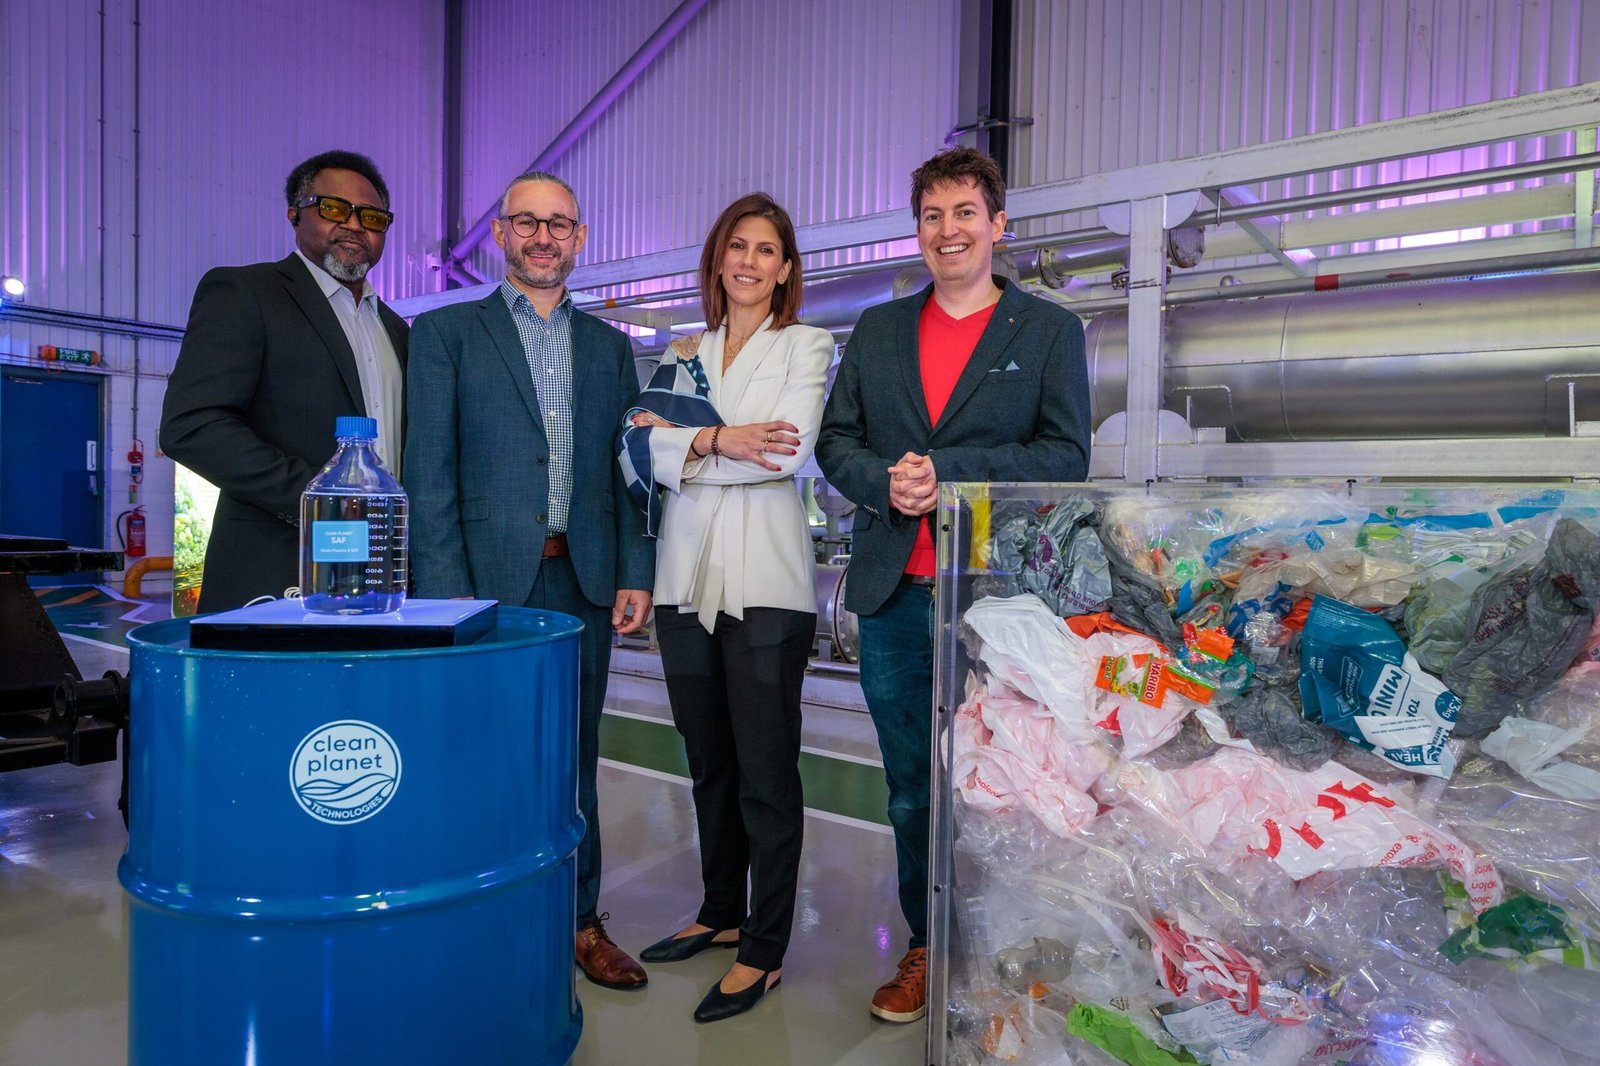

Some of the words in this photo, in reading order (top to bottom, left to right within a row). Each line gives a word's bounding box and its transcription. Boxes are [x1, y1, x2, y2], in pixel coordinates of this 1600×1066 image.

[331, 536, 347, 544] SAF
[1144, 662, 1162, 700] HARIBO
[1374, 669, 1403, 710] MINI
[313, 734, 377, 753] clean
[308, 754, 383, 777] planet
[311, 795, 383, 819] TECHNOLOGIES
